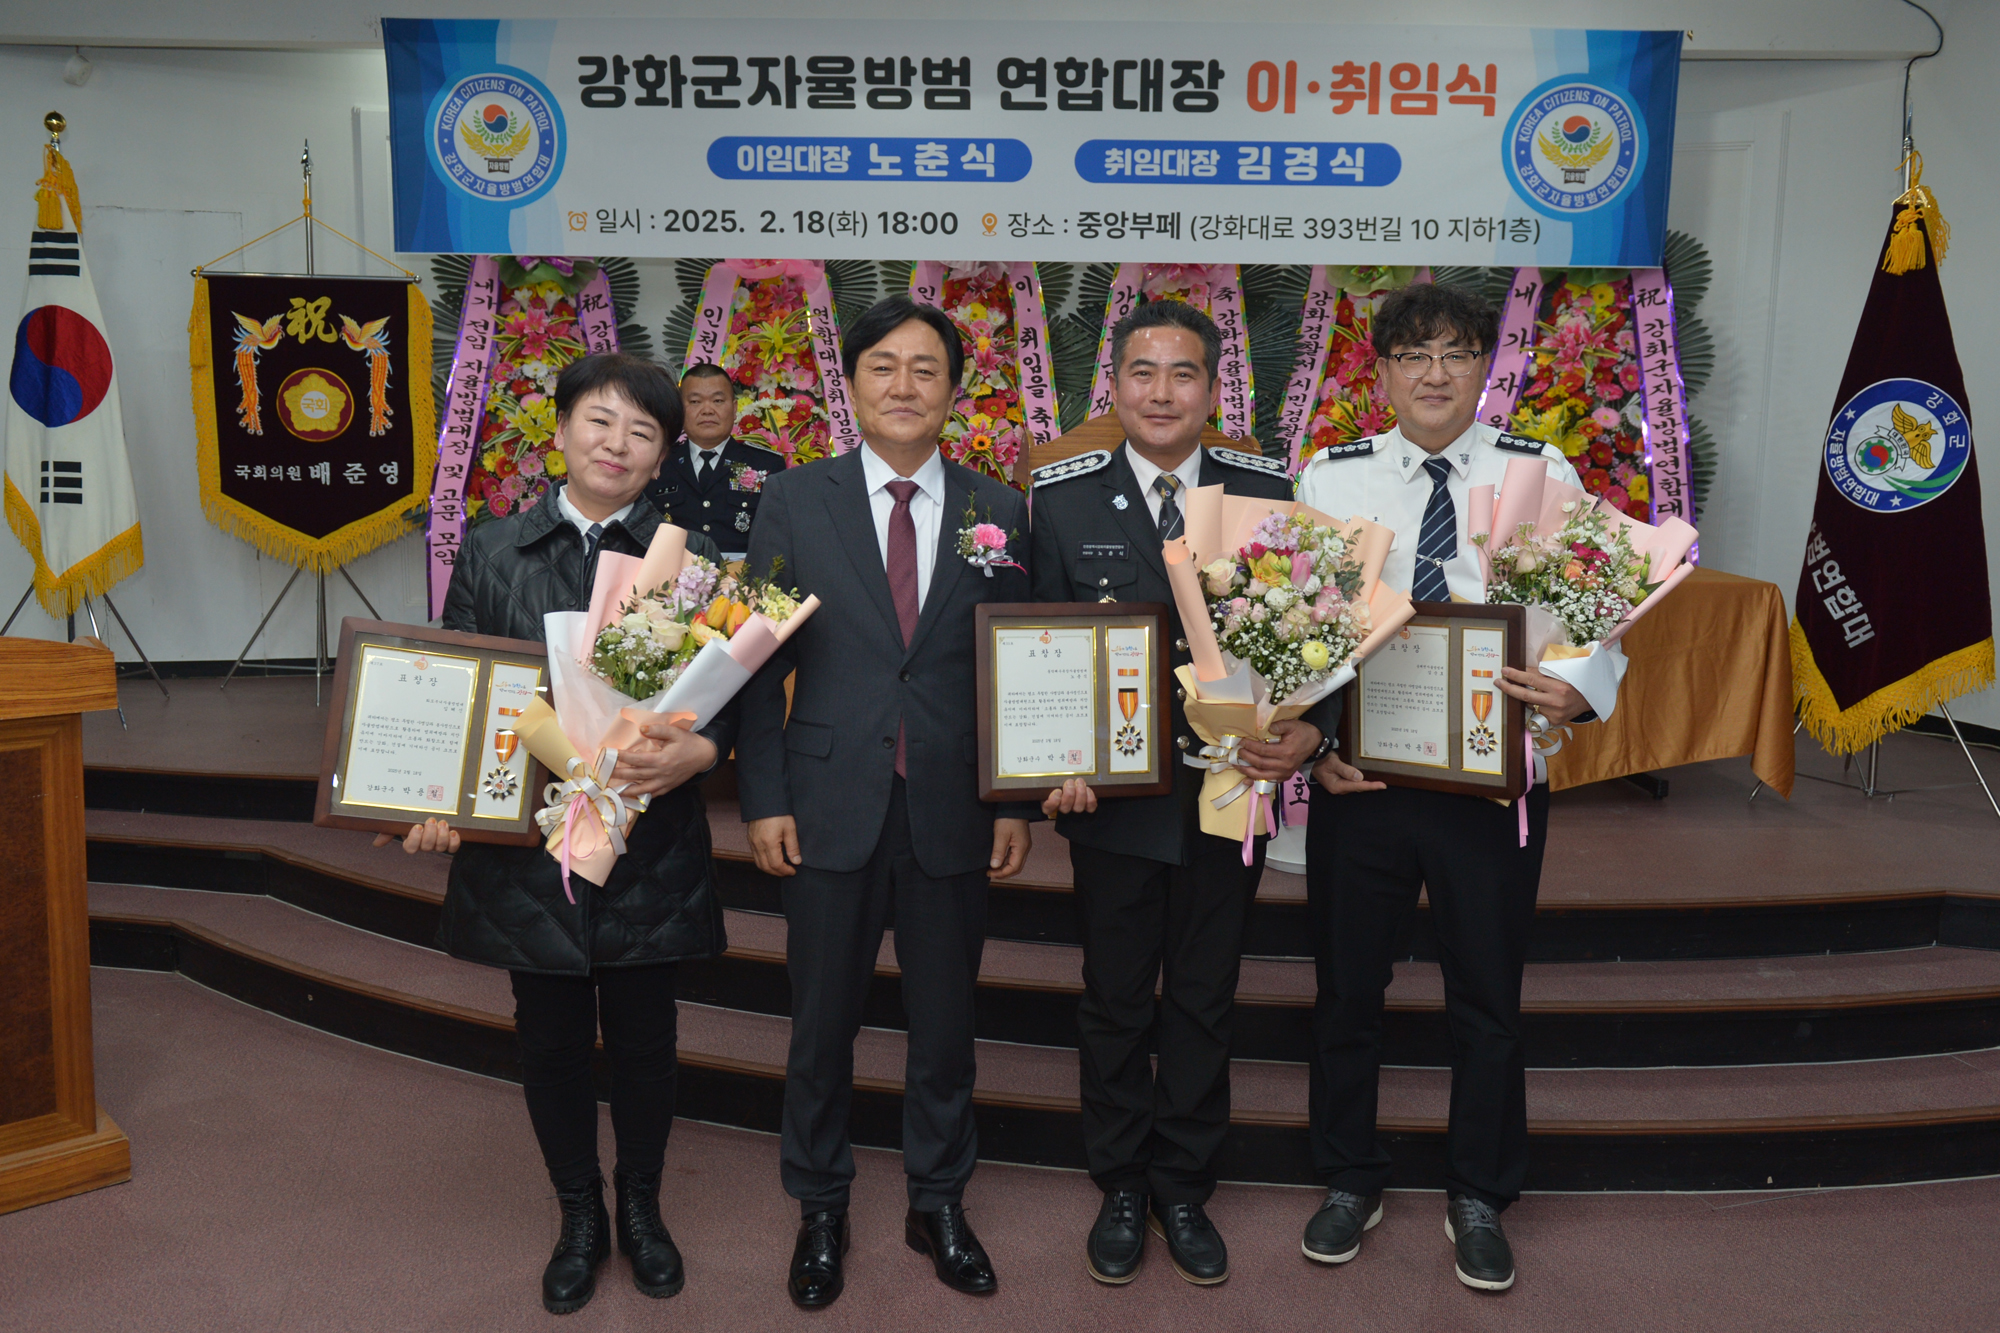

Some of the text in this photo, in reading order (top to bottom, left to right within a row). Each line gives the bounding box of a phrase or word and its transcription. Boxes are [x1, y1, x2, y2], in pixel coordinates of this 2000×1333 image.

[577, 53, 1498, 117] 강화군자율방범 연합대장 이·취임식
[441, 79, 550, 133] KOREA CITIZENS ON PATROL
[1518, 90, 1632, 143] KOREA CITIZENS ON PATROL
[444, 152, 550, 196] 강화군자율방범연합대
[737, 143, 851, 174] 이임대장
[1104, 146, 1219, 177] 취임대장
[1520, 163, 1628, 207] 강화군자율방범연합대
[664, 209, 746, 235] 2025.
[759, 211, 786, 235] 2.
[795, 208, 868, 238] 18(화)
[877, 211, 959, 235] 18:00
[1076, 212, 1181, 241] 중앙부페
[1189, 215, 1295, 241] (강화대로
[1302, 216, 1402, 242] 393번길
[1411, 218, 1440, 240] 10
[1447, 216, 1541, 245] 지하1층)
[471, 278, 497, 310] 내가
[581, 293, 609, 313] 祝
[465, 319, 490, 351] 전임
[301, 397, 329, 412] 국회
[445, 359, 488, 456] 자율방범대장
[1636, 287, 1688, 518] 祝 강화군자율방범연합대
[234, 464, 302, 482] 국회의원
[442, 463, 464, 479] 및
[1829, 428, 1880, 506] 자율방범연합대
[433, 489, 461, 522] 고문
